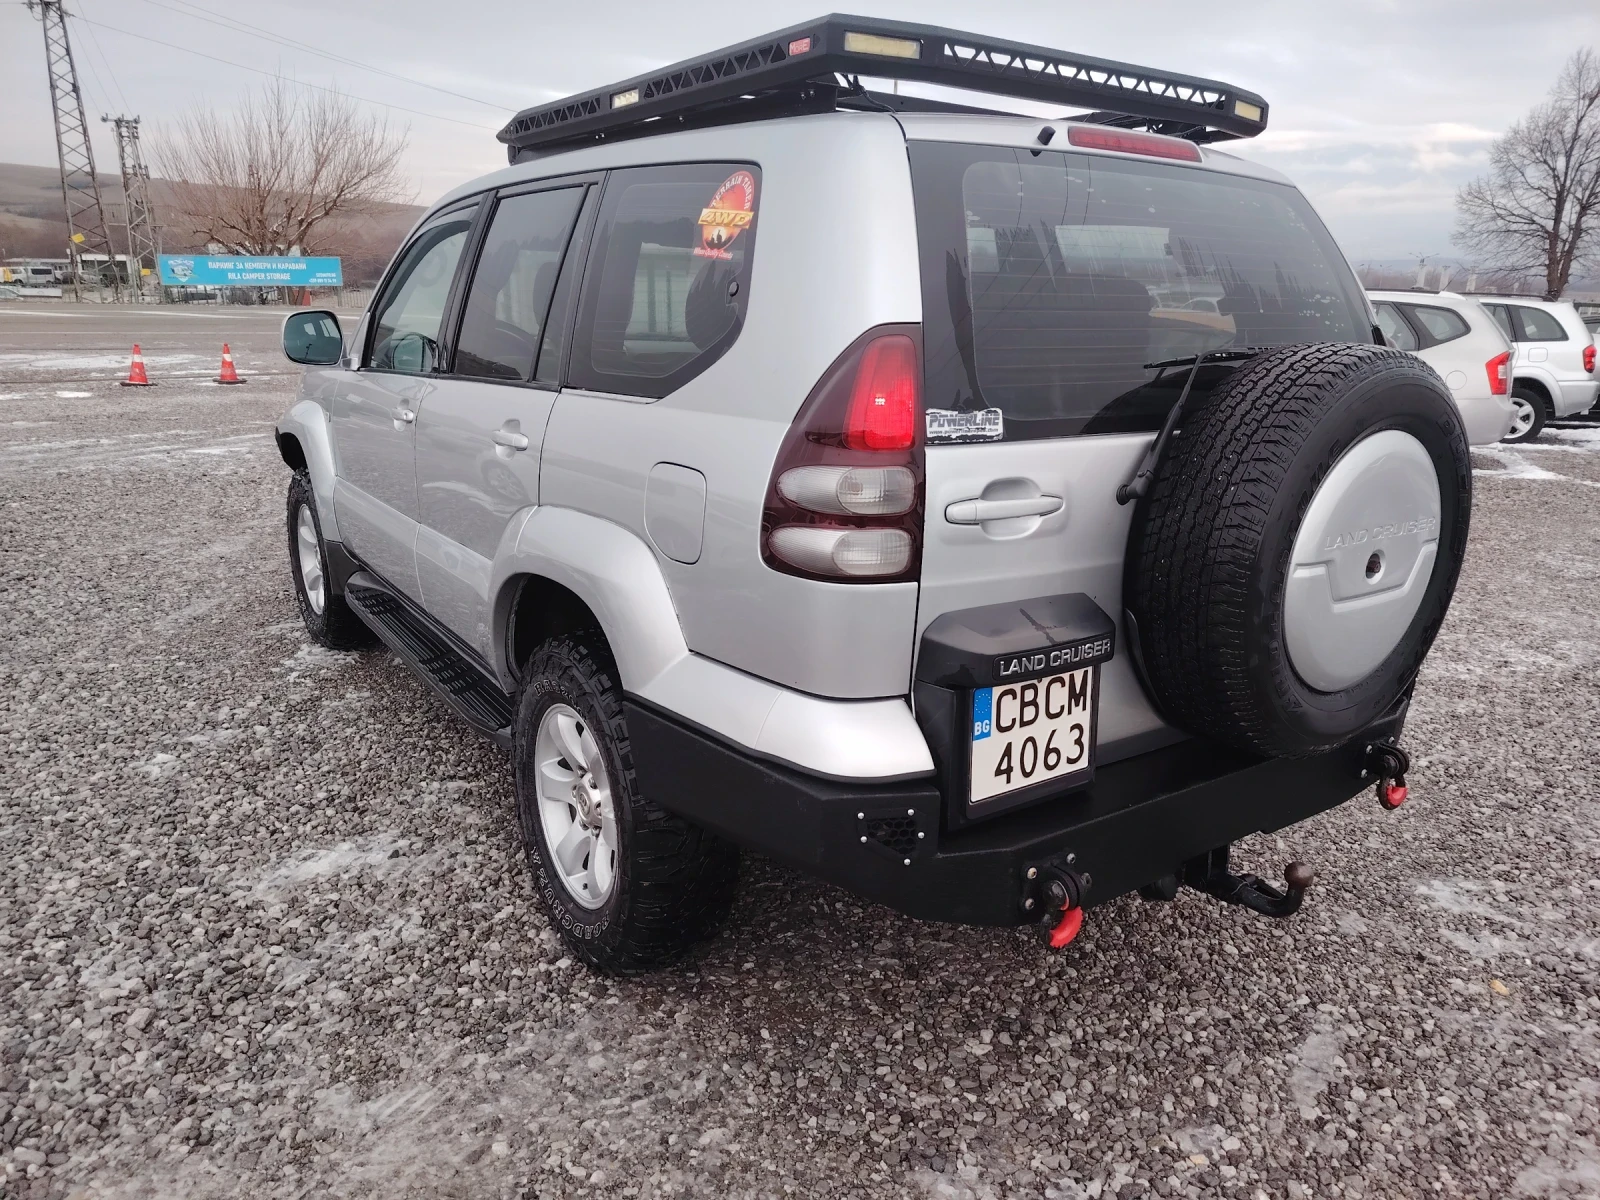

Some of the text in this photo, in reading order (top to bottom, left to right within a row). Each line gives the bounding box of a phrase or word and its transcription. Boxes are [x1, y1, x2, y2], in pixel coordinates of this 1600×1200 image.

[711, 175, 752, 210] TERRAIN TAMER
[699, 211, 751, 228] 4WD
[208, 261, 307, 270] ПАРКИНГ ЗА КЕМПЕРИ И КАРАВАНИ
[227, 272, 291, 280] RILA CAMPER STORAGE
[929, 413, 1000, 428] POWERLINE
[1323, 516, 1437, 550] LAND CRUISER
[1000, 638, 1111, 677] LAND CRUISER
[995, 669, 1089, 733] CBCM
[974, 719, 990, 736] BG
[994, 722, 1085, 785] 4063
